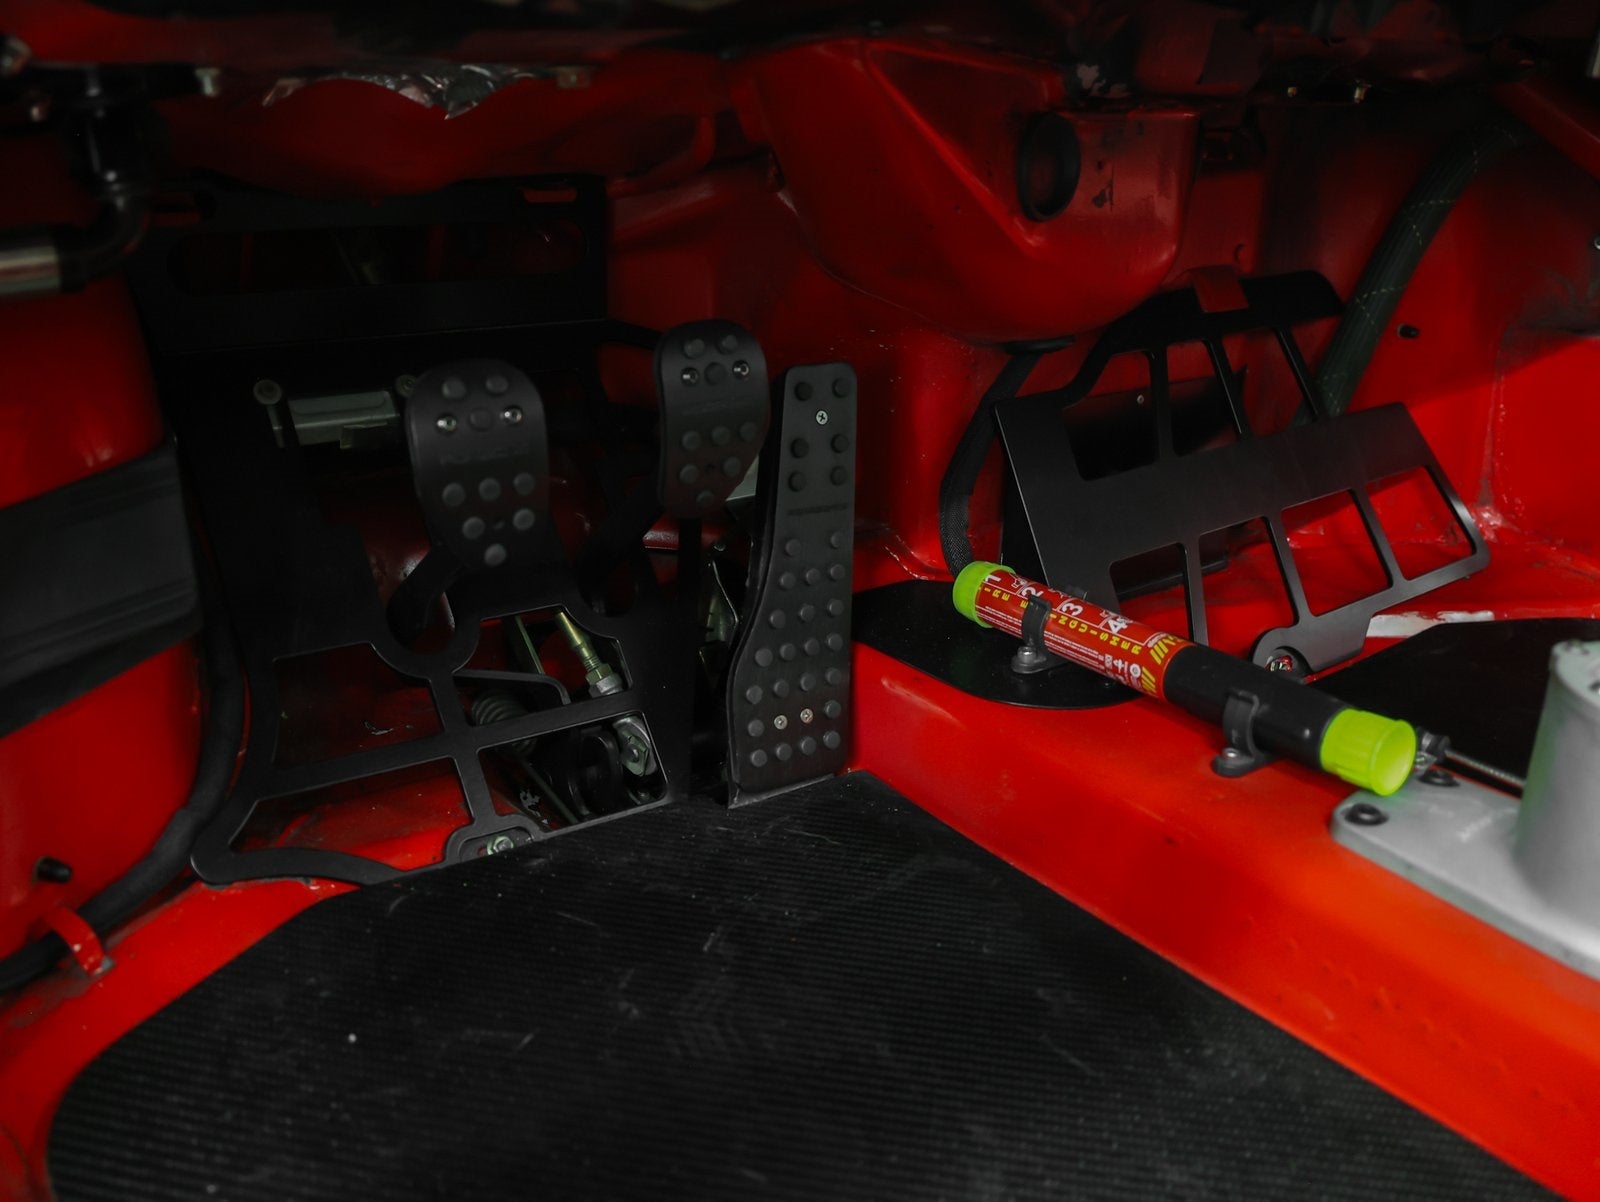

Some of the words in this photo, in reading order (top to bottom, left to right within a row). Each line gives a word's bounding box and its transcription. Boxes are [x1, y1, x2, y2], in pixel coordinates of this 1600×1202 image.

[1062, 602, 1083, 616] 3
[979, 587, 1010, 601] IRE
[1021, 600, 1142, 655] EINGUISHER
[1108, 616, 1128, 633] 4
